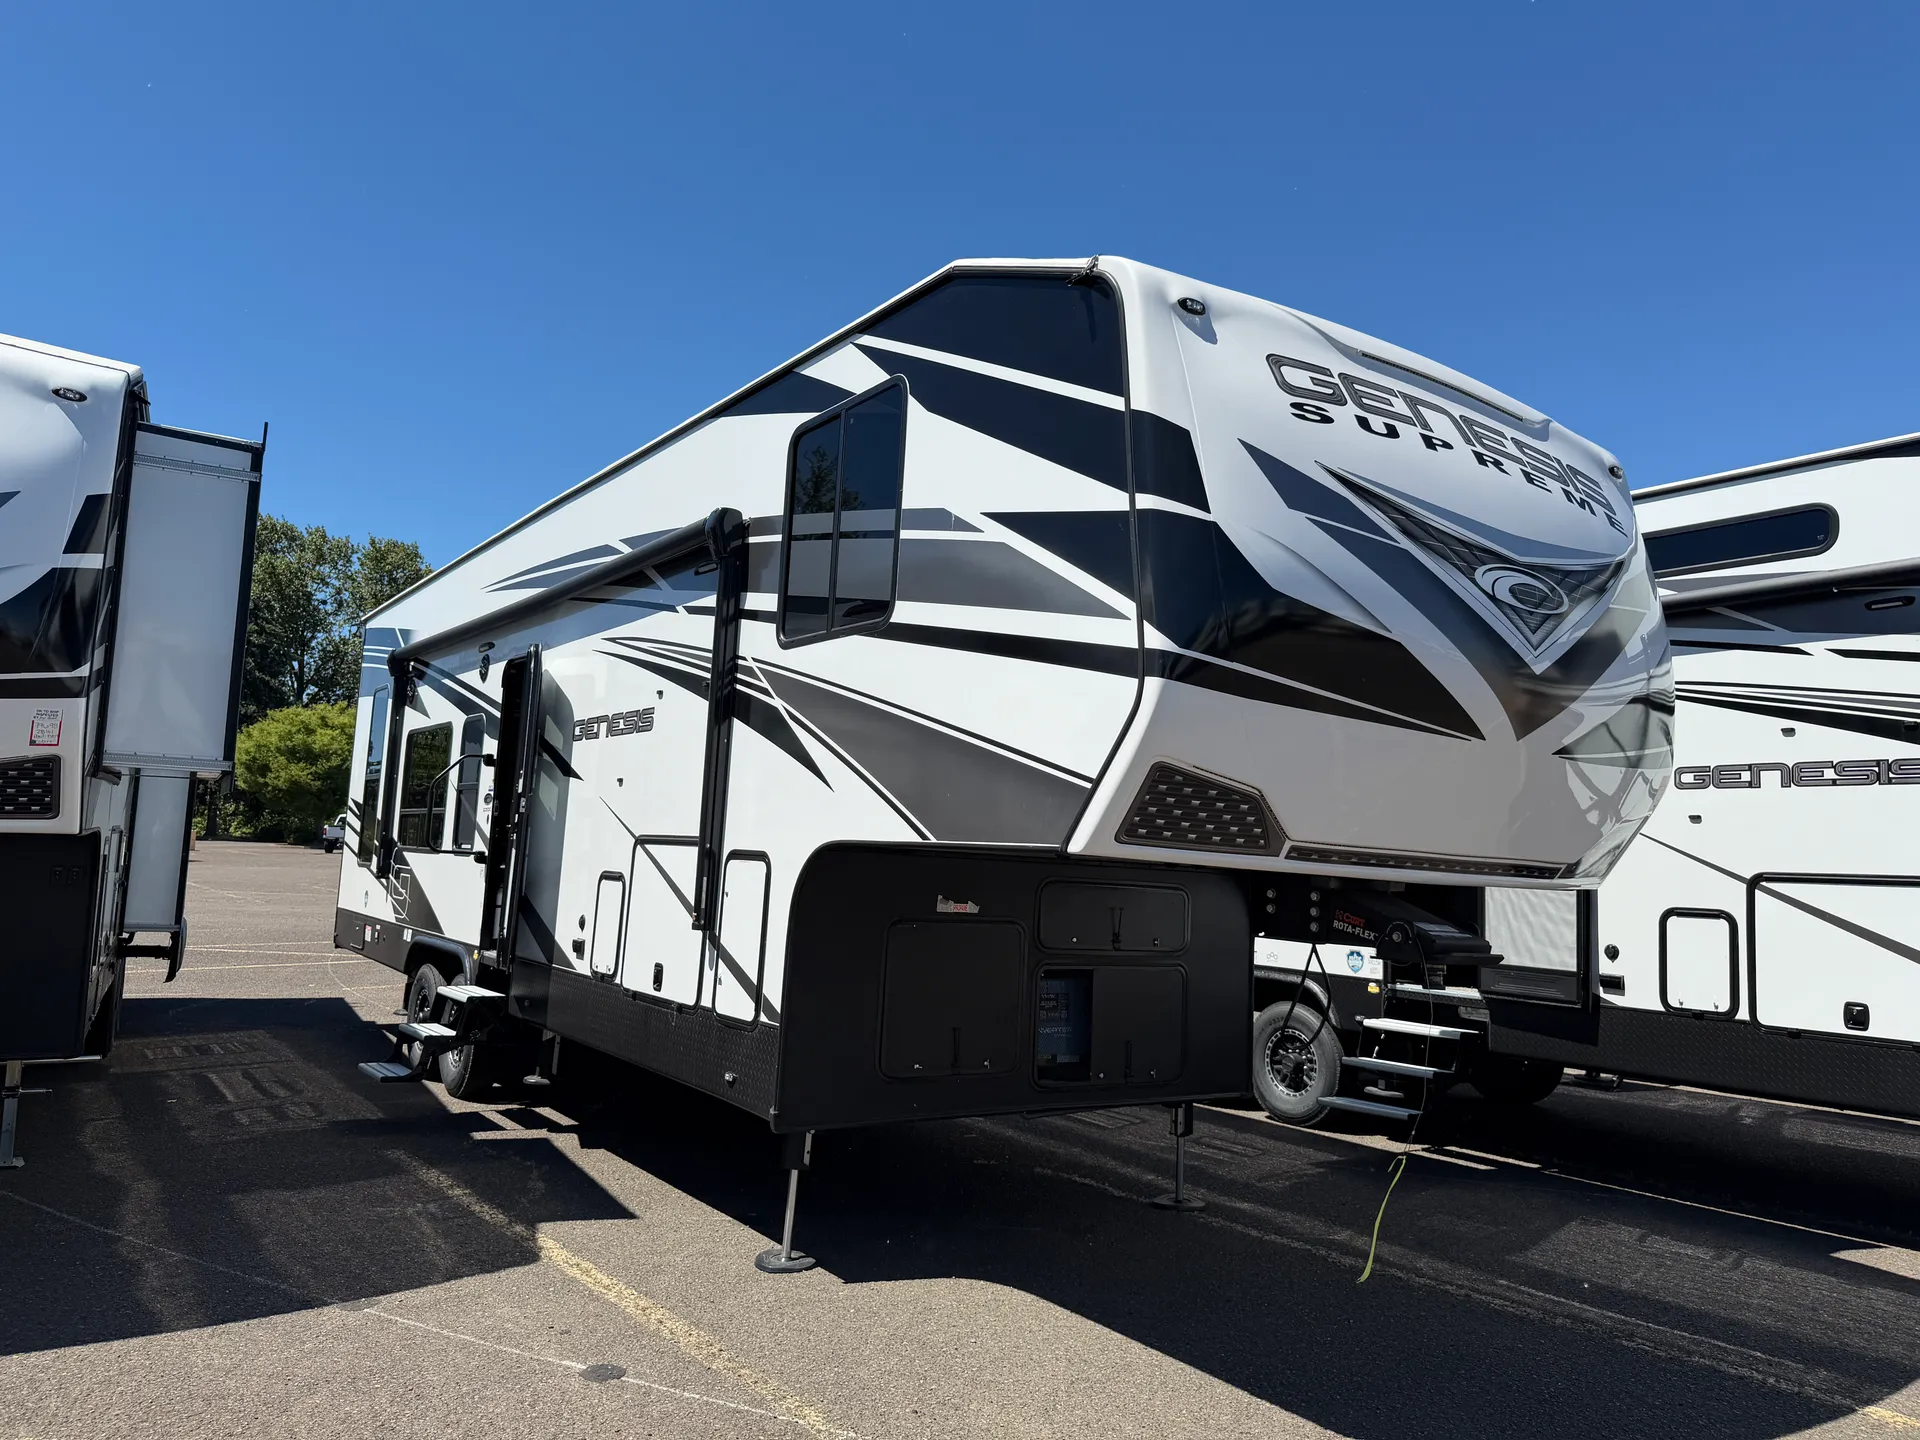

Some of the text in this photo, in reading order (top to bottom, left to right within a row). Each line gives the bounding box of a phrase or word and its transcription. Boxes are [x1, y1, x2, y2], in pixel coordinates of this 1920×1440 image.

[1265, 353, 1617, 518] GENESIS
[1289, 401, 1628, 538] SUPREME
[573, 707, 655, 741] GENESIS
